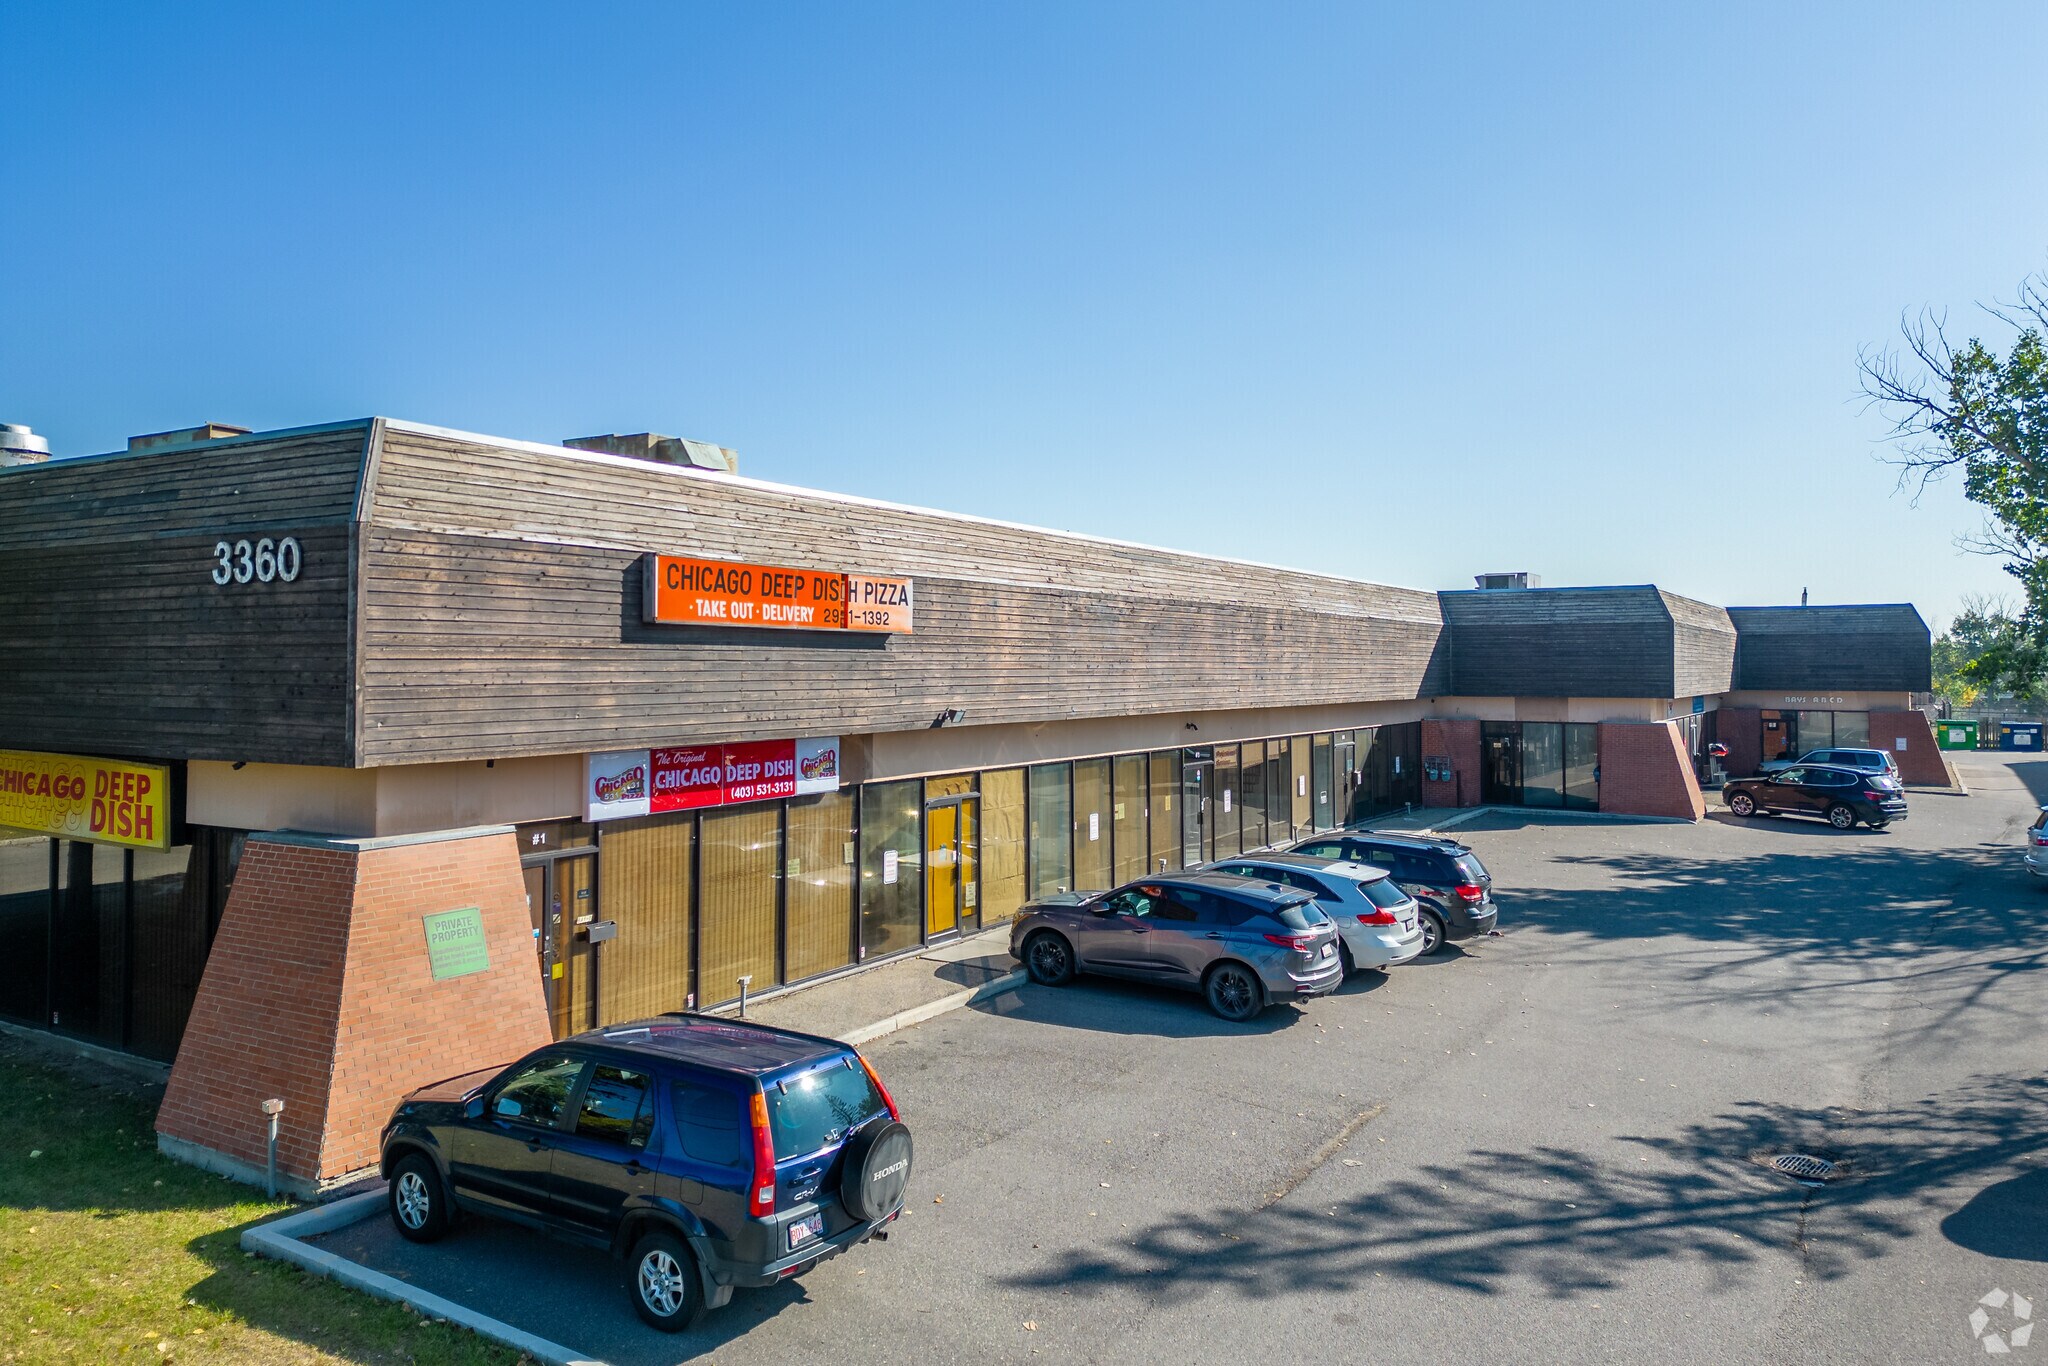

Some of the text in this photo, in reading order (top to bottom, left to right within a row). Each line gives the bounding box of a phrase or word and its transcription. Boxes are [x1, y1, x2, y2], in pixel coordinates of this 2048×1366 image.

[211, 536, 300, 585] 3360
[666, 563, 909, 606] CHICAGO DEEP DISH PIZZA
[695, 599, 815, 623] TAKE OUT DELIVERY
[823, 608, 890, 626] 291-1392
[656, 751, 706, 766] The Original
[800, 749, 836, 777] CHICAGO
[594, 766, 645, 798] CHICAGO
[655, 766, 721, 789] CHICAGO
[726, 763, 760, 783] DEEP
[764, 759, 794, 778] DISH
[94, 769, 151, 804] DEEP
[731, 781, 794, 799] (403) 531-3131
[89, 798, 154, 841] DISH
[532, 833, 547, 845] #1
[431, 925, 480, 944] PROPERTY
[434, 916, 473, 932] PRIVATE
[872, 1158, 909, 1182] HONDA
